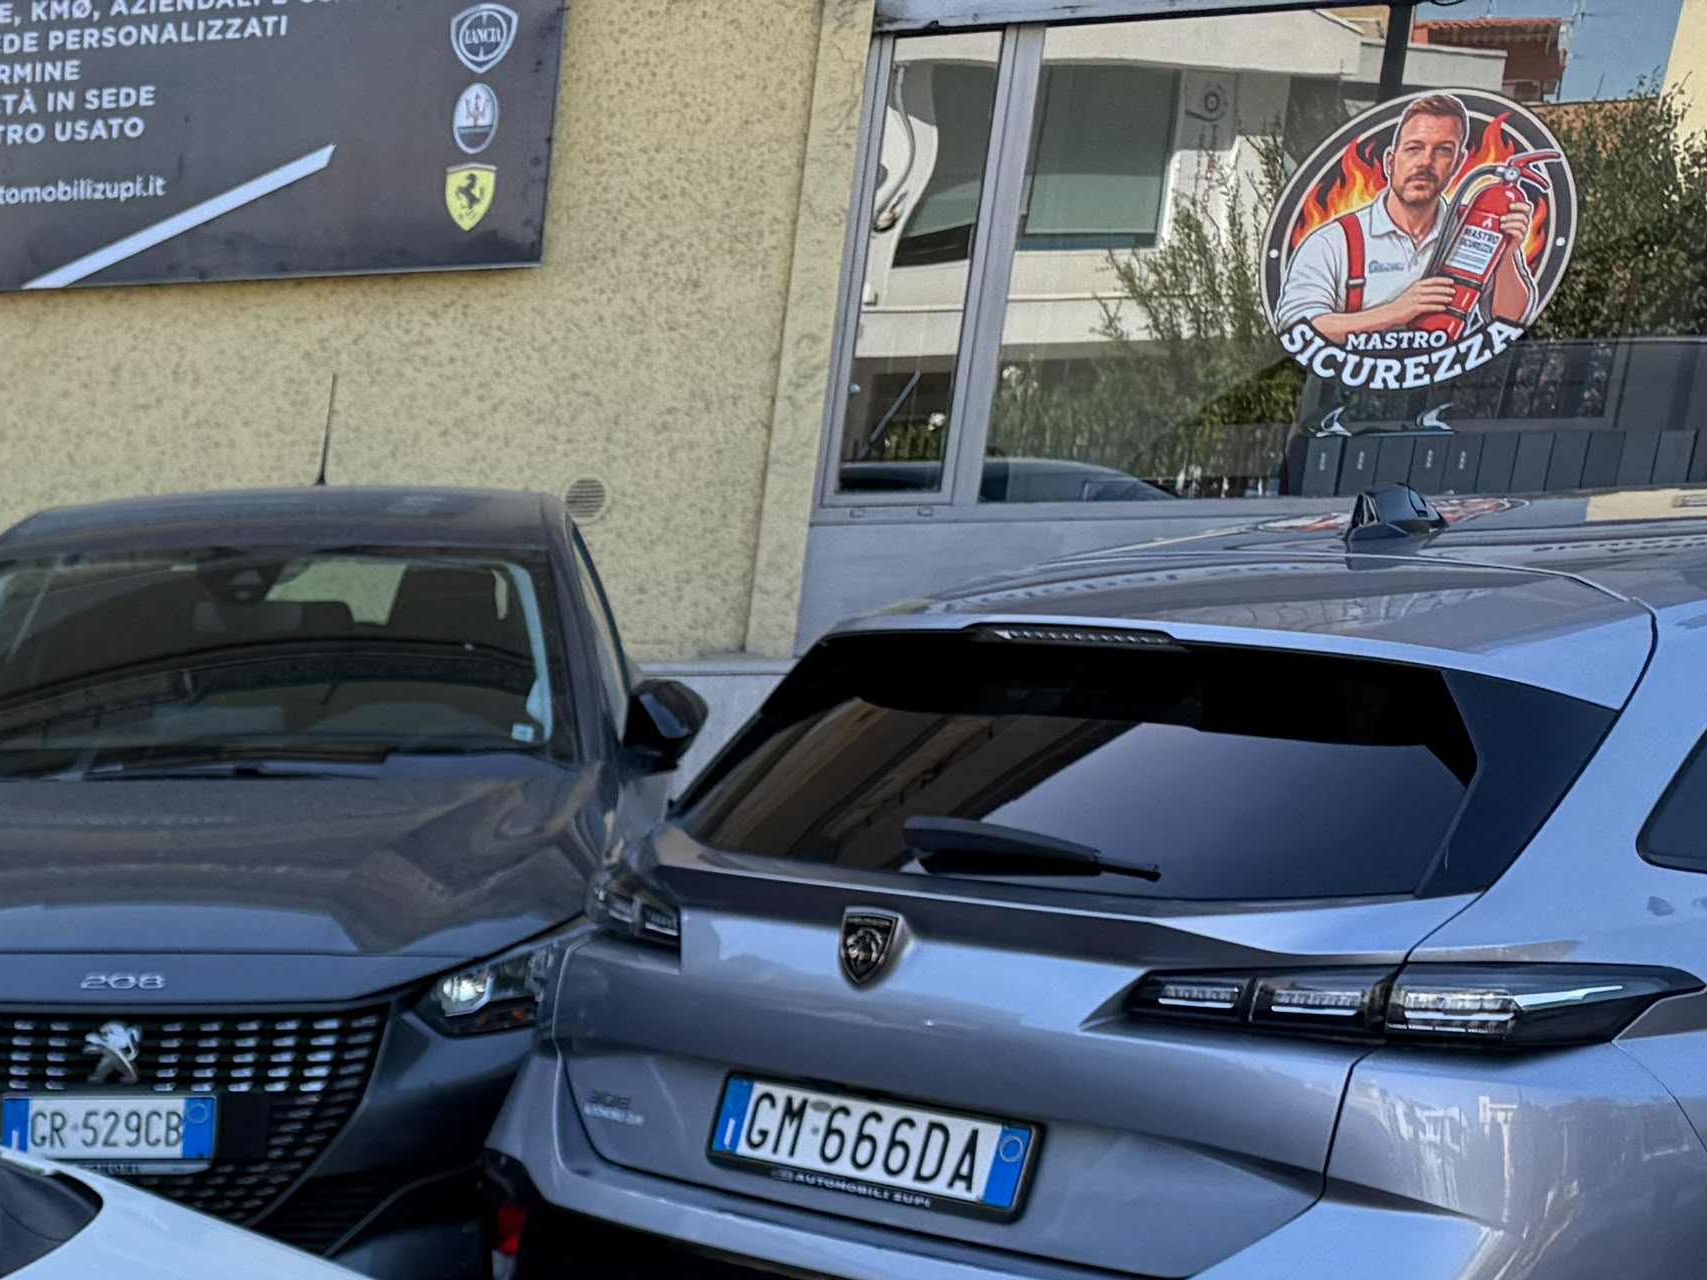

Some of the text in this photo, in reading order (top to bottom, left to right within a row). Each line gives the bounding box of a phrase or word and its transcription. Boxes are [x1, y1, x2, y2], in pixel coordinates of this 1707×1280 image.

[48, 15, 289, 52] PERSONALIZZATI
[464, 27, 502, 45] LANCIA
[46, 91, 75, 113] IN
[84, 85, 156, 110] SEDE
[54, 117, 145, 142] USATO
[1346, 330, 1448, 351] MASTRO
[1280, 319, 1526, 390] SICUREZZA
[80, 973, 166, 990] 208
